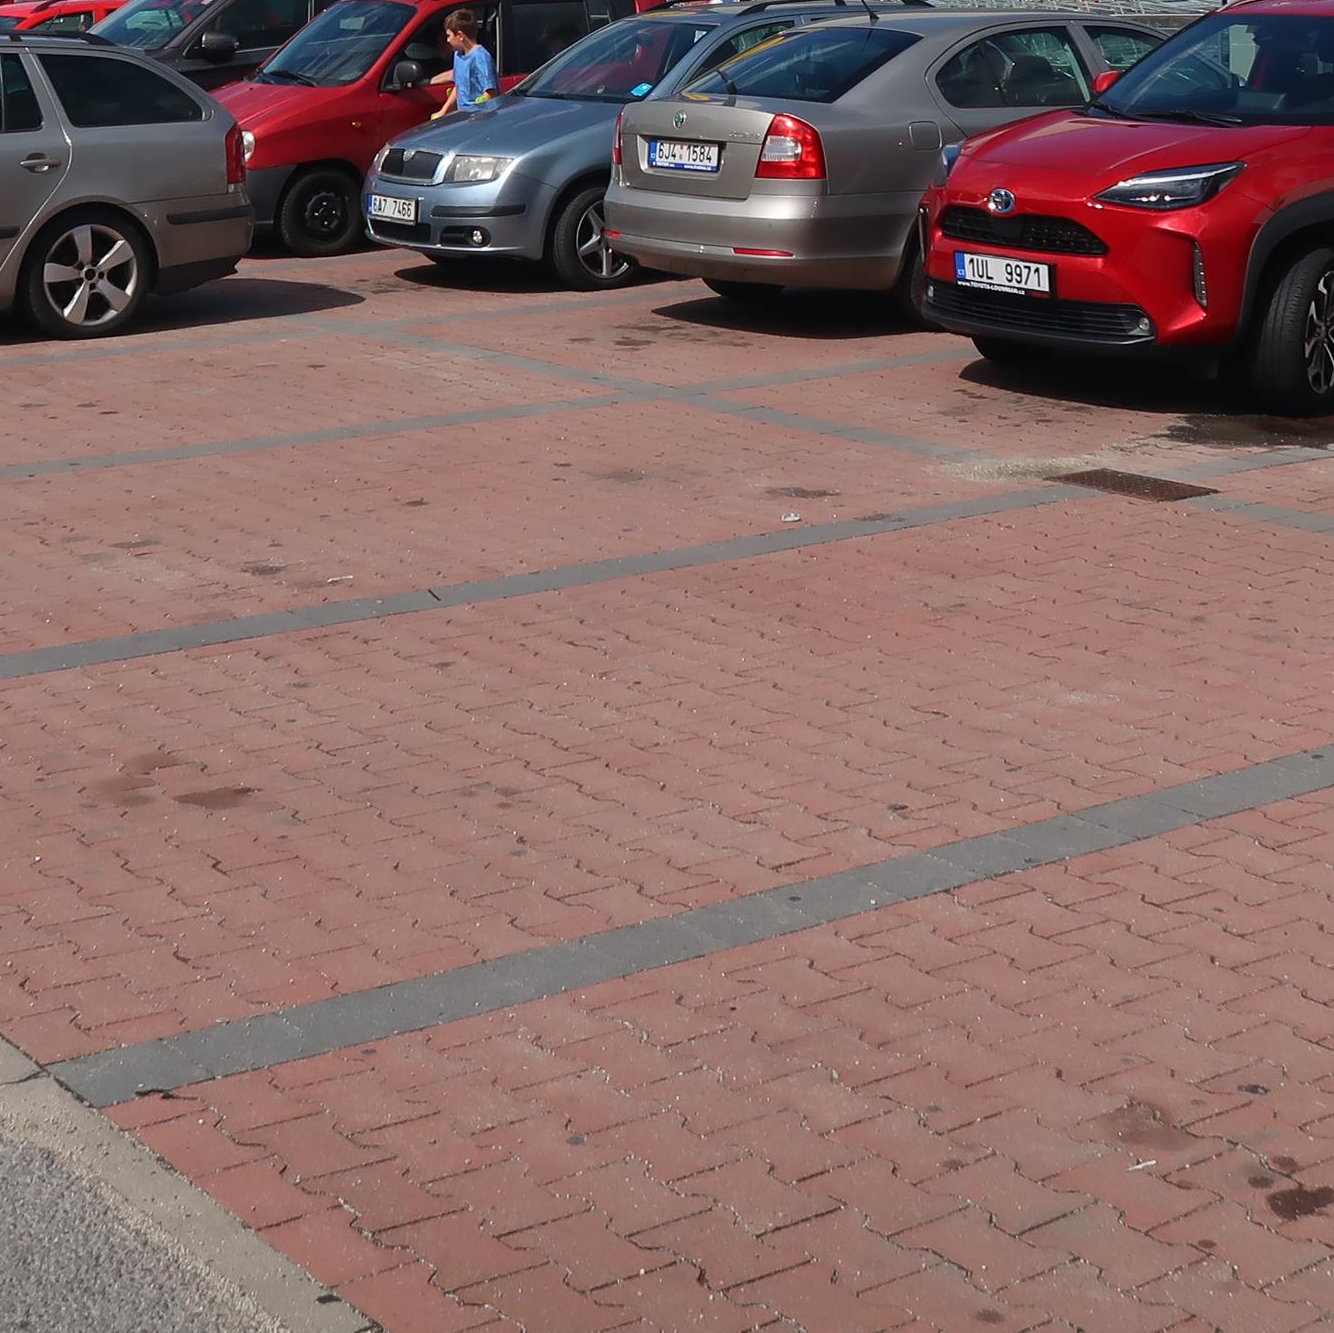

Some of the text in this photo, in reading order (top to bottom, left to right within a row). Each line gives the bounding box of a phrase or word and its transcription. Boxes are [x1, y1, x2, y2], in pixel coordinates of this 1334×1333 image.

[658, 142, 712, 163] 6J4 1584
[393, 200, 411, 218] 7466
[969, 258, 993, 280] 1UL
[1005, 263, 1042, 287] 9971
